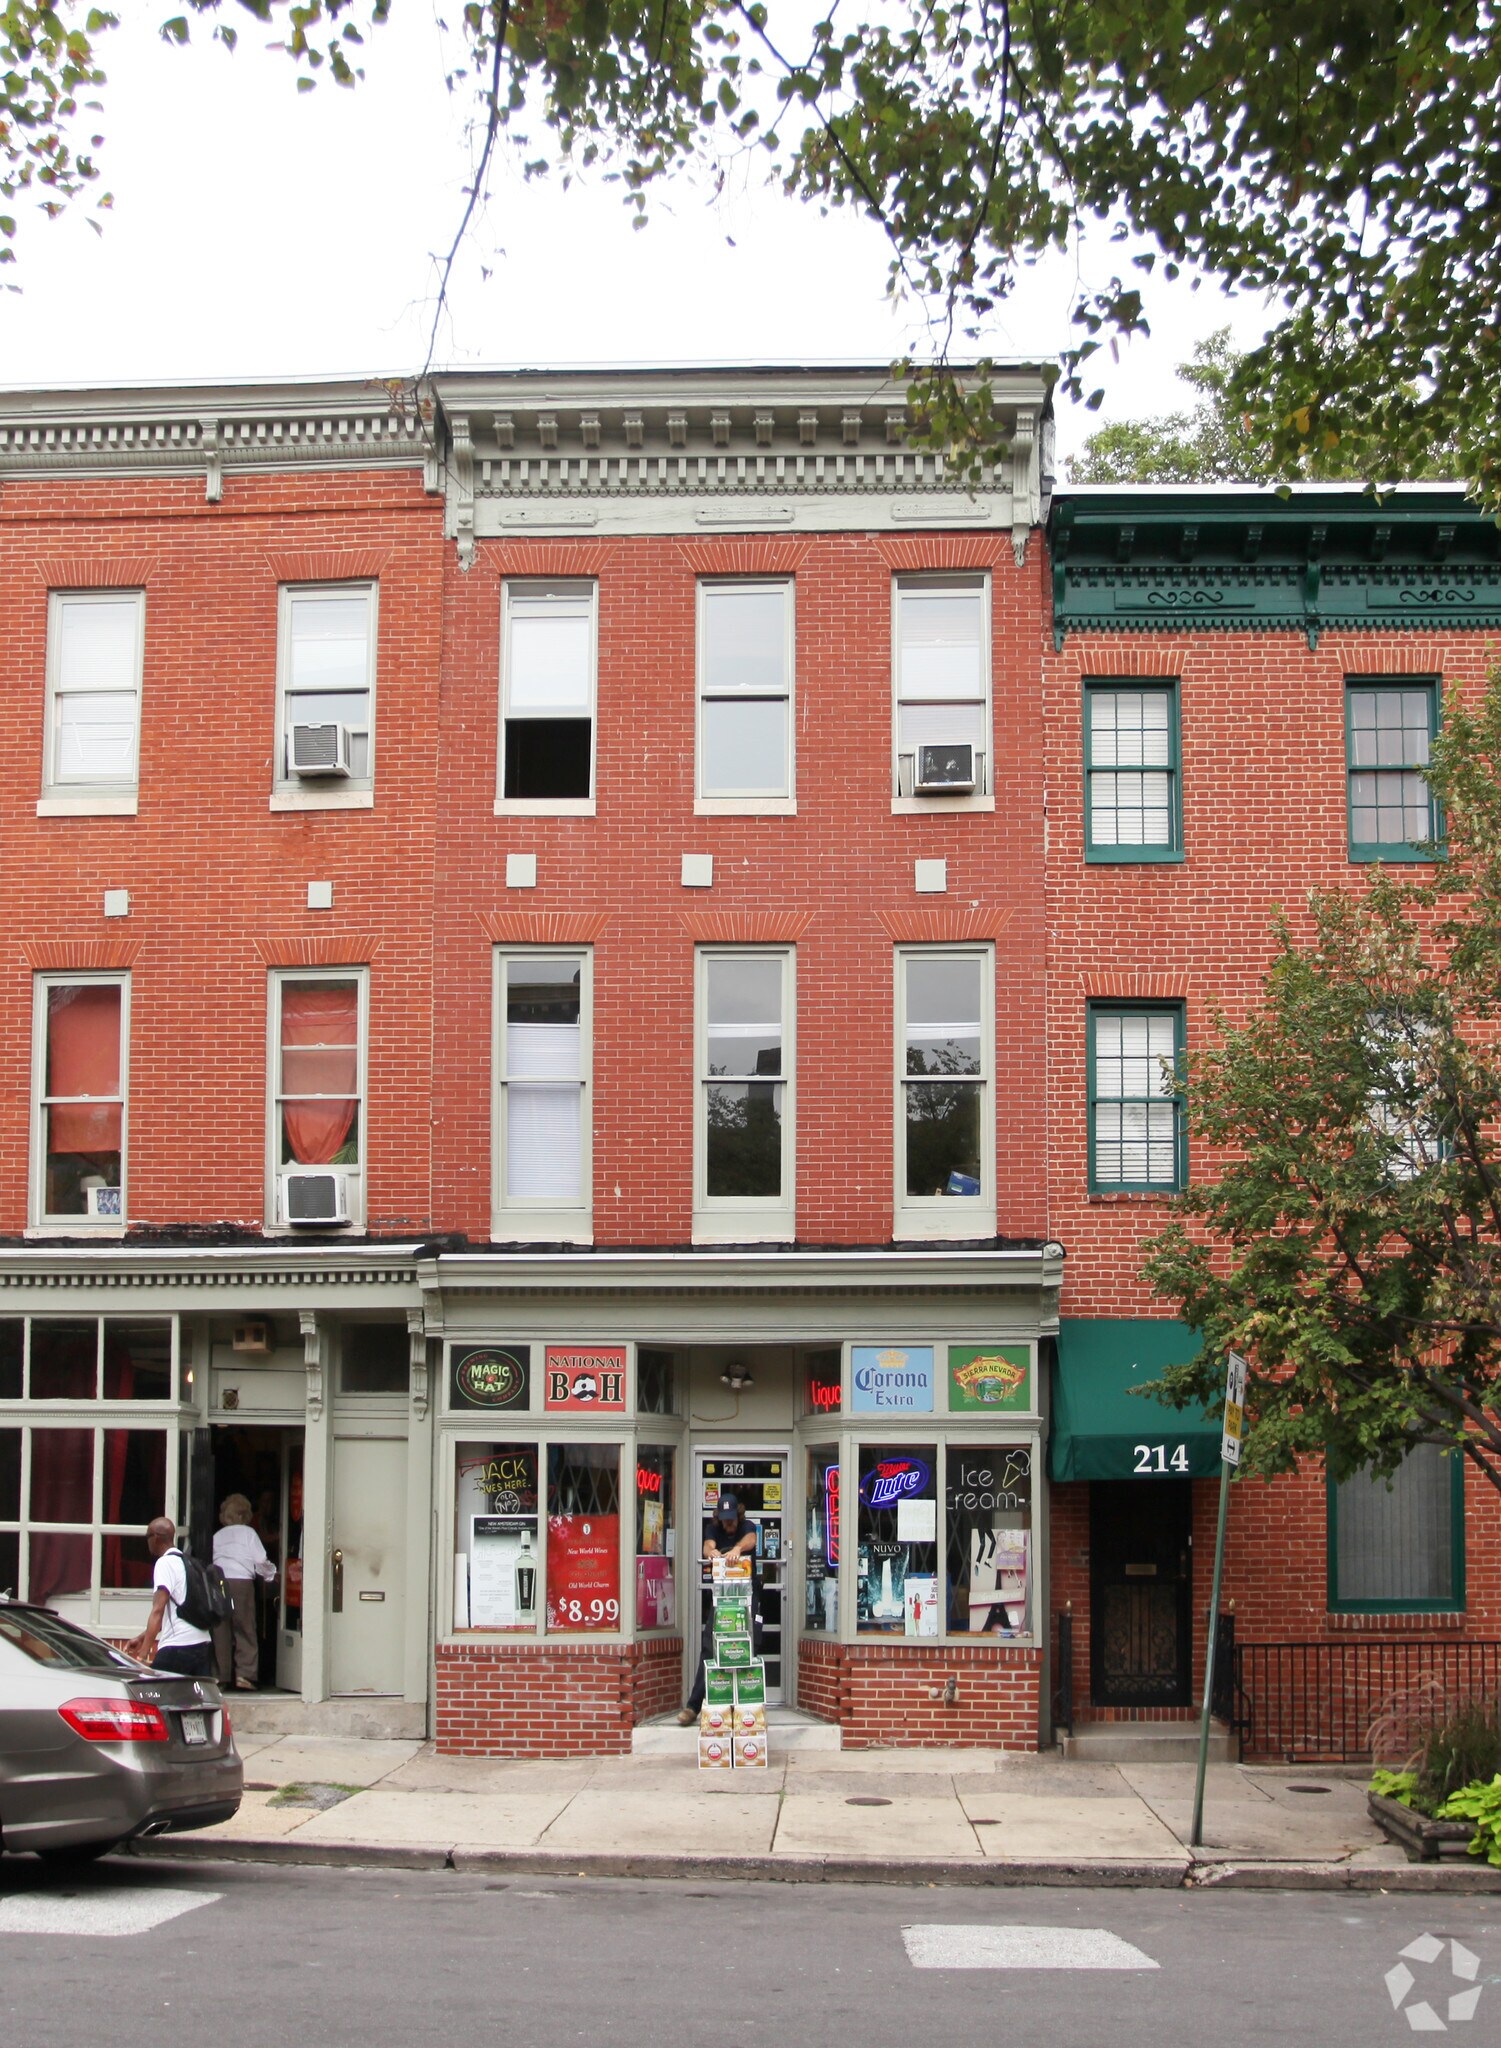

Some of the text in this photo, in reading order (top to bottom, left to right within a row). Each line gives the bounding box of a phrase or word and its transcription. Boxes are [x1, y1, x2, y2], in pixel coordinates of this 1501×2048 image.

[471, 1364, 510, 1379] MAGIC
[549, 1356, 622, 1368] NATIONAL
[855, 1367, 928, 1394] Corona
[963, 1364, 1017, 1381] SIERRA NEVADA
[474, 1380, 505, 1393] HAT
[811, 1380, 842, 1412] Liquo
[875, 1390, 914, 1406] Extra
[1133, 1443, 1189, 1473] 214
[480, 1459, 528, 1481] JACK
[724, 1464, 743, 1475] 216
[961, 1464, 994, 1487] Ice
[636, 1464, 662, 1495] iquor
[871, 1472, 920, 1504] Lite
[765, 1531, 779, 1539] OPEN
[873, 1544, 902, 1553] NUVO
[559, 1597, 619, 1622] $8.99
